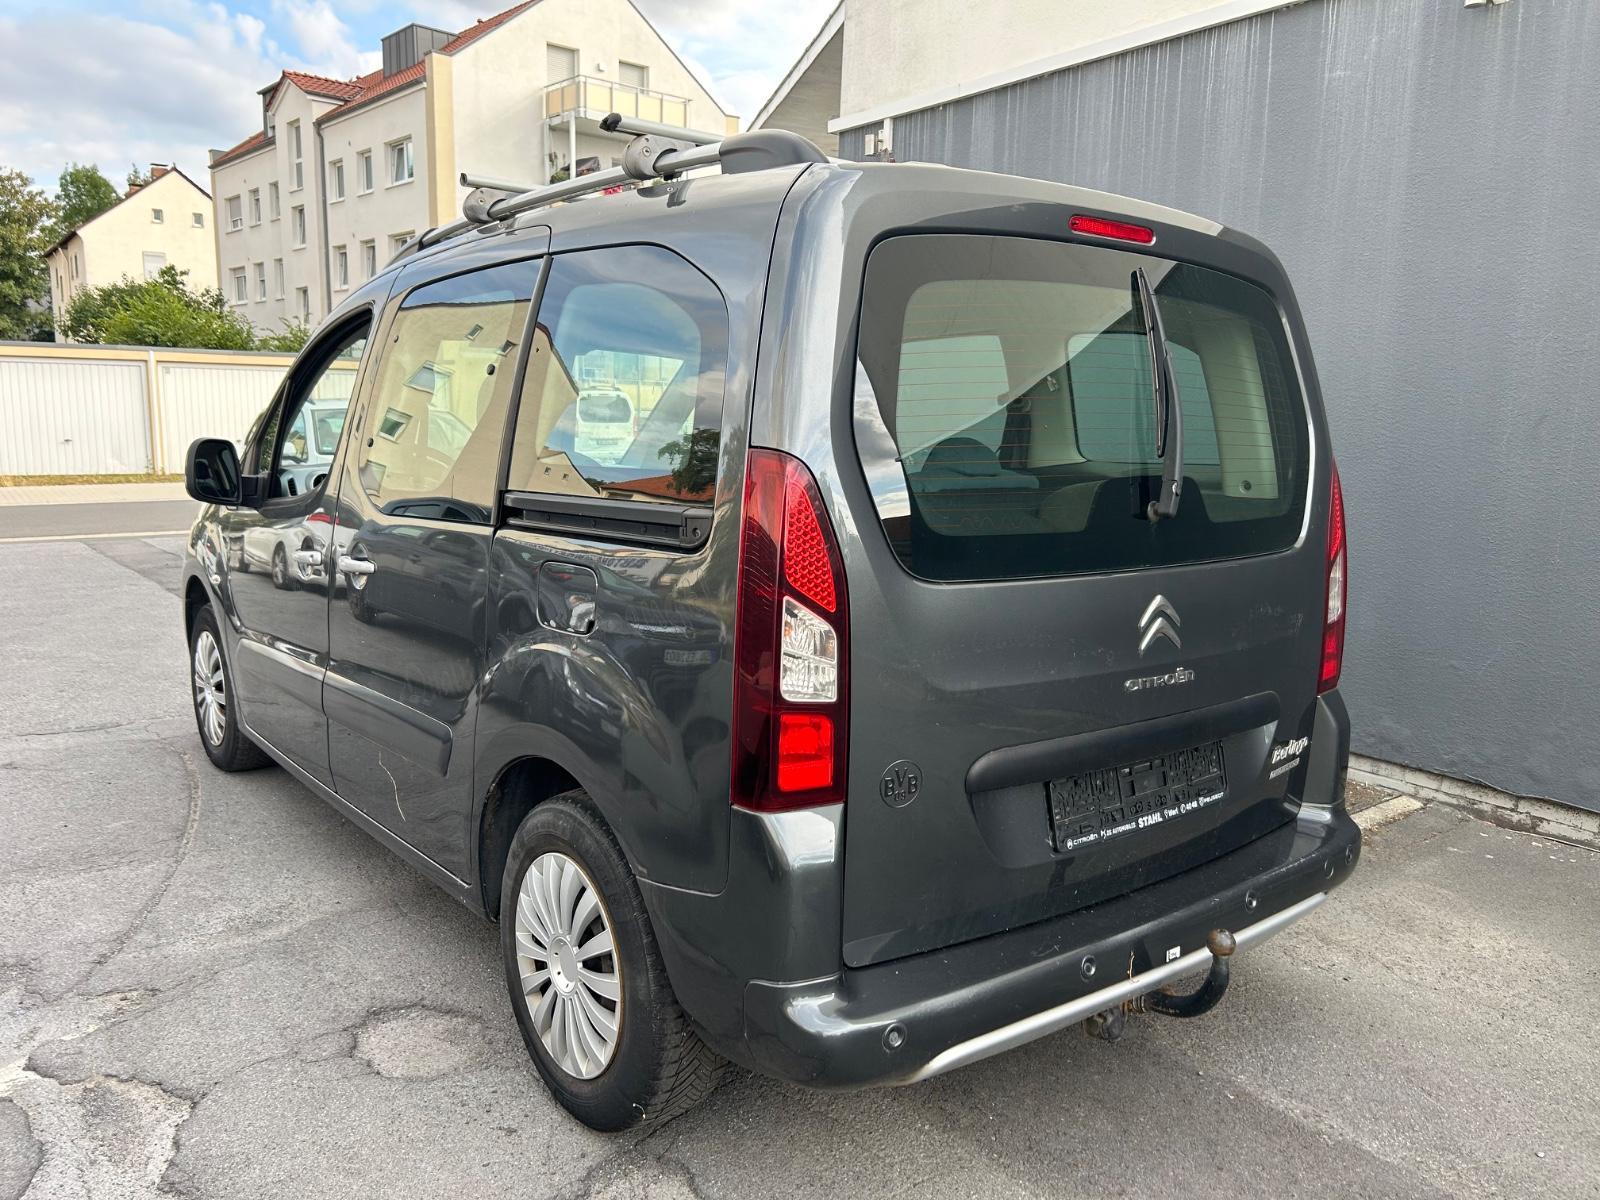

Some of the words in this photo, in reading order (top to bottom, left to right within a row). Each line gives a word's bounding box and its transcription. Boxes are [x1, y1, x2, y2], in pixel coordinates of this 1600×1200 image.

[1124, 667, 1195, 691] CITROËN
[1271, 736, 1309, 764] Berlingo
[884, 767, 918, 798] BVB
[1137, 811, 1163, 828] STAHL
